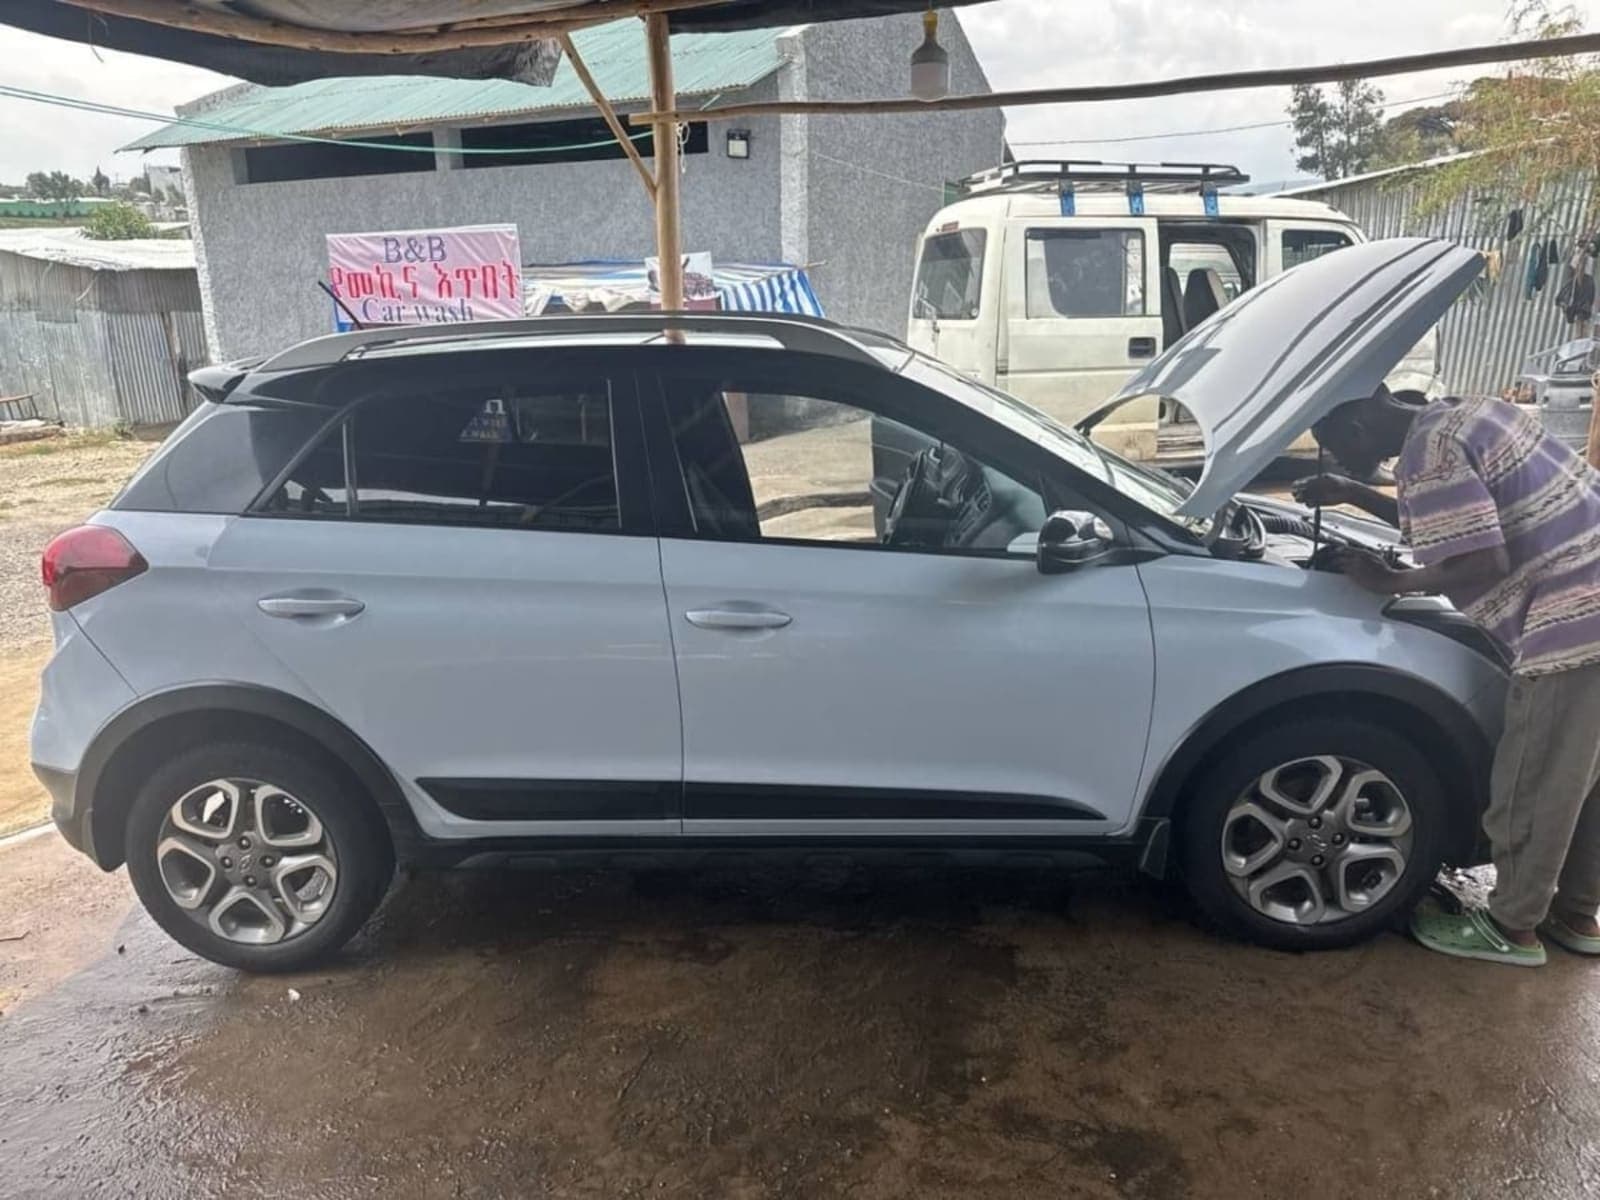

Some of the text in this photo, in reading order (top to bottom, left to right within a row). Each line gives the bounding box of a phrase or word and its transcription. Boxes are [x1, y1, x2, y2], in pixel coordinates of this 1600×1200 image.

[383, 235, 447, 264] B&B
[330, 260, 520, 300] የመኪና እጥበት
[362, 297, 474, 321] Car wash
